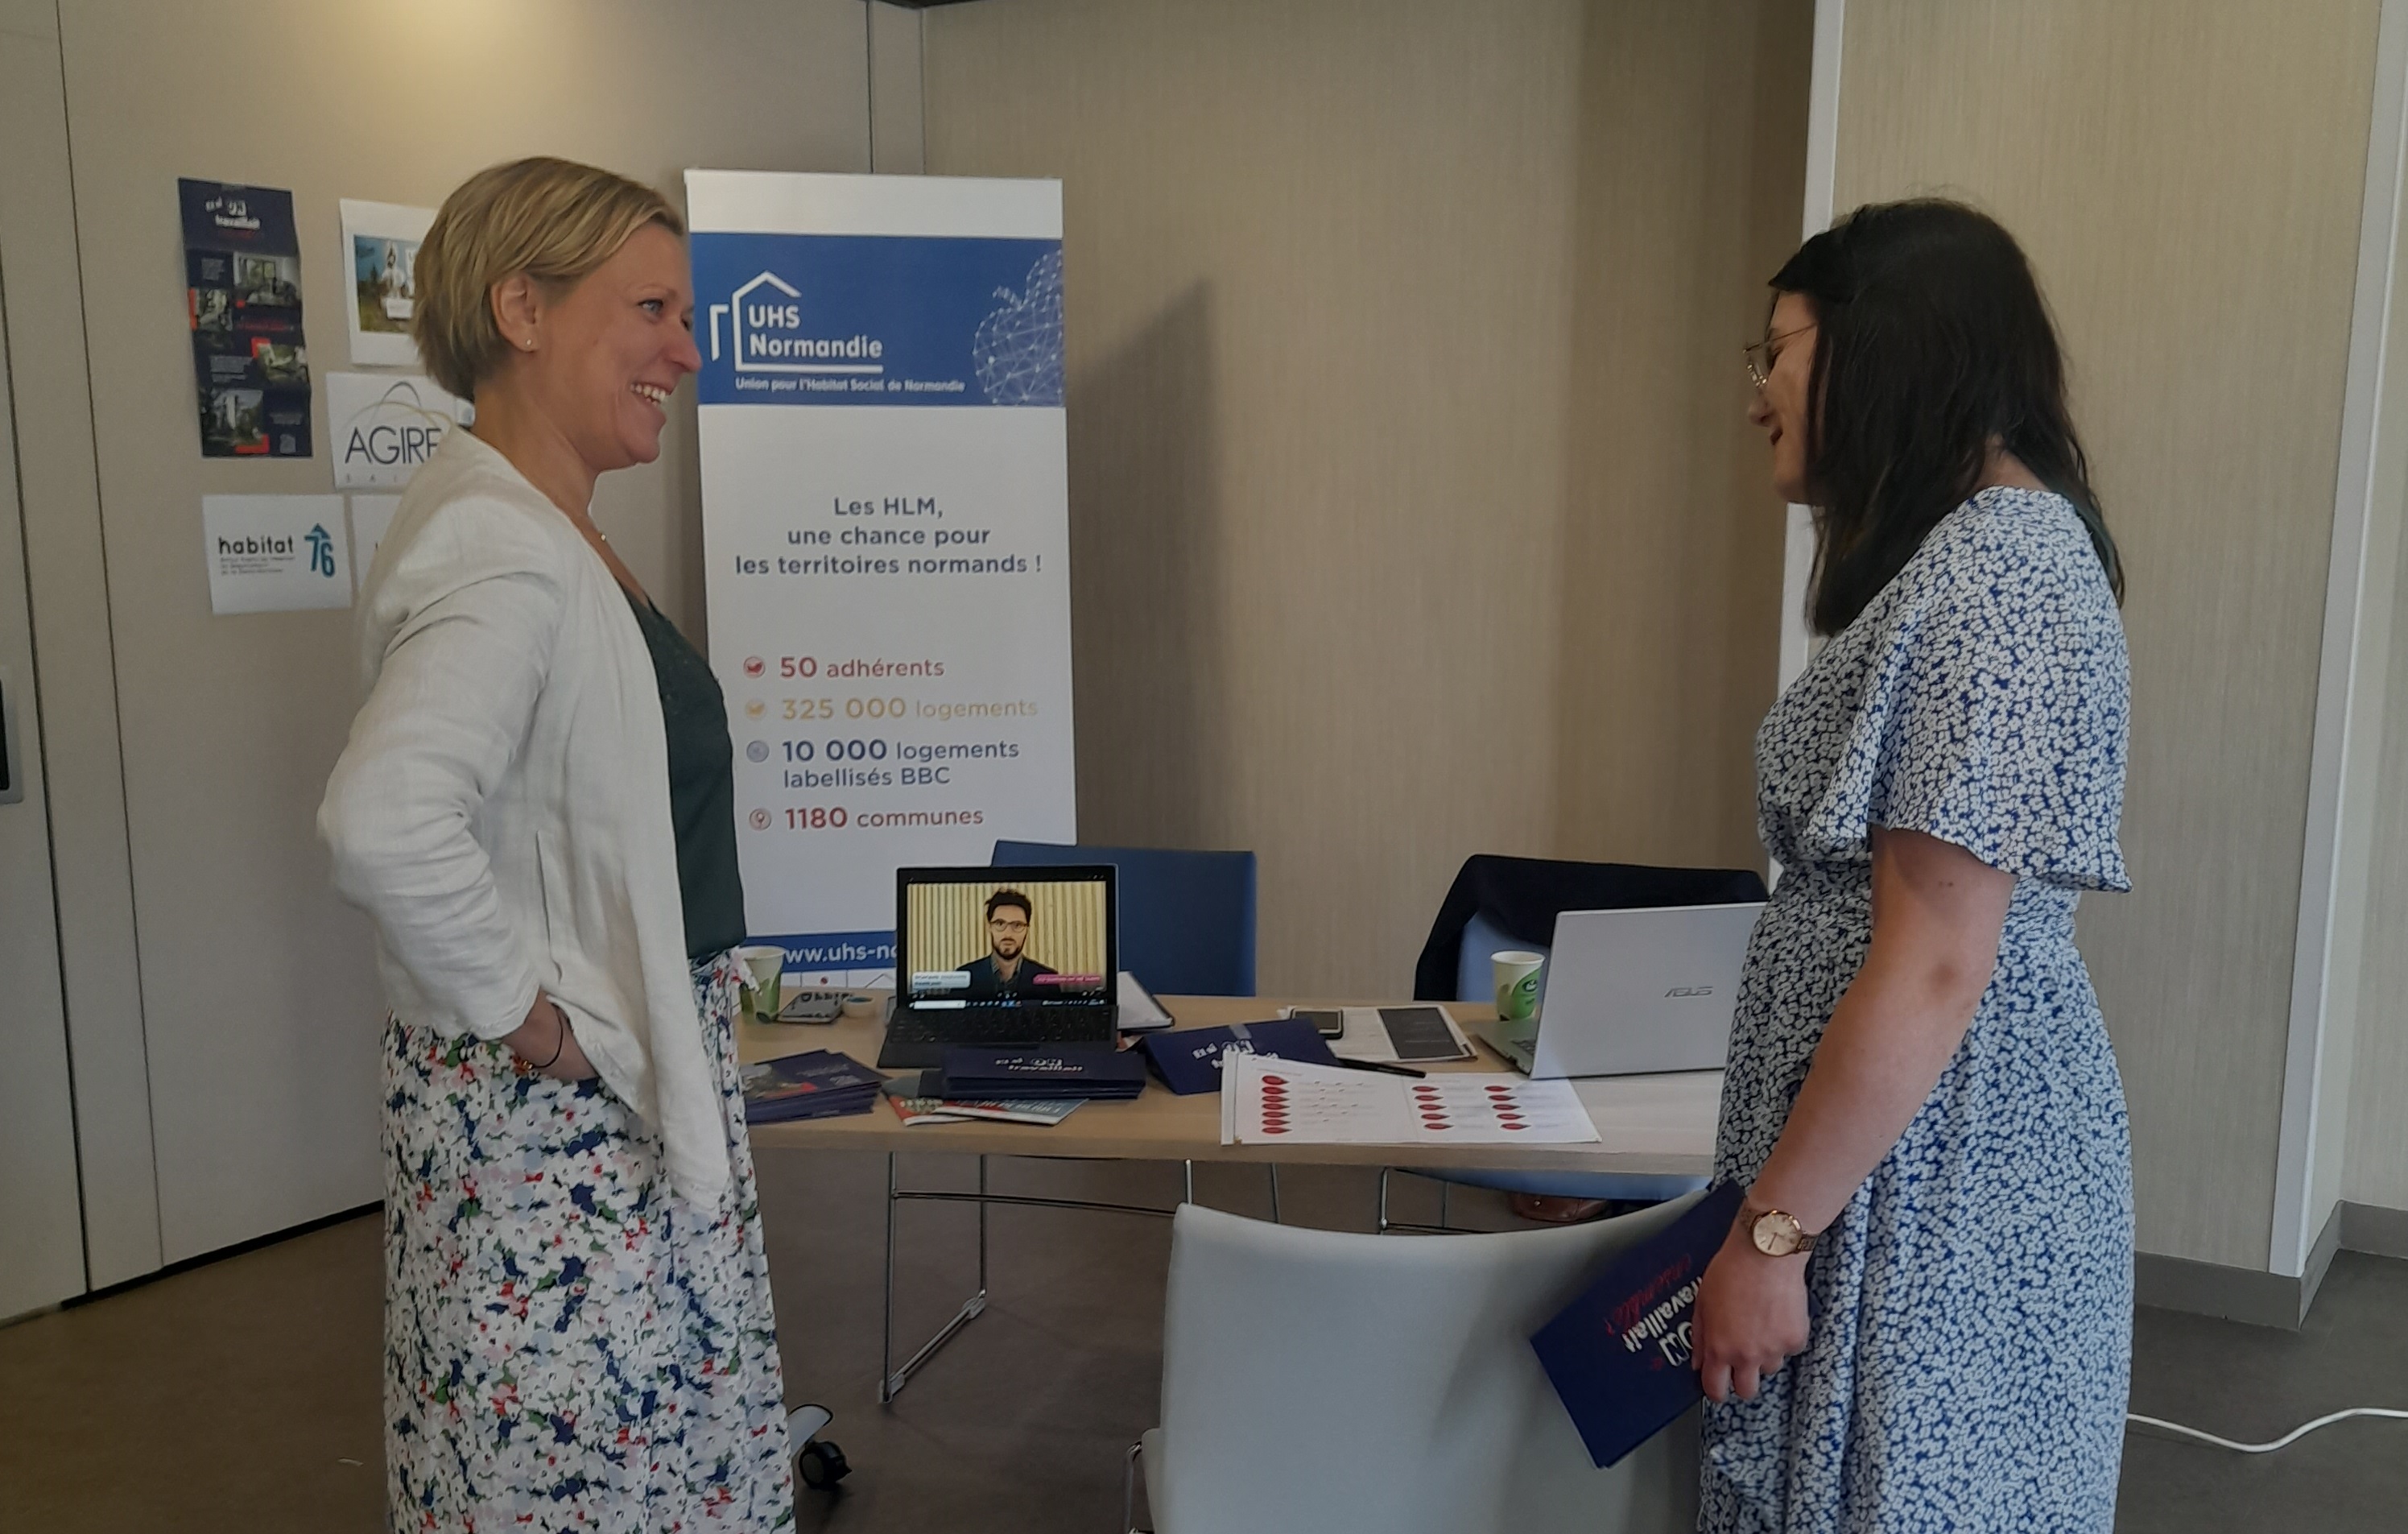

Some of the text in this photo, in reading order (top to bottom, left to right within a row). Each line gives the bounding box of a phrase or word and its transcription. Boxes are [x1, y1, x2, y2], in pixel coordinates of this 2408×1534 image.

[748, 304, 801, 329] UHS
[749, 333, 884, 359] Normandie
[735, 376, 769, 391] Union
[770, 378, 797, 393] pour
[850, 378, 884, 392] Social
[887, 378, 902, 392] de
[904, 379, 965, 393] Normandie
[834, 497, 944, 519] Les HLM,
[218, 535, 294, 555] habitat
[787, 526, 991, 548] une chance pour
[304, 535, 336, 578] 76
[735, 556, 770, 574] les
[778, 555, 899, 574] territoires
[907, 554, 1028, 573] normands
[779, 656, 945, 679] 50 adhérents
[782, 697, 1039, 722] 325 000 logements
[782, 738, 1020, 763] 10 000 logements
[783, 766, 952, 788] labellisés BBC
[784, 807, 985, 830] 1180 communes
[1663, 986, 1714, 999] ASUS
